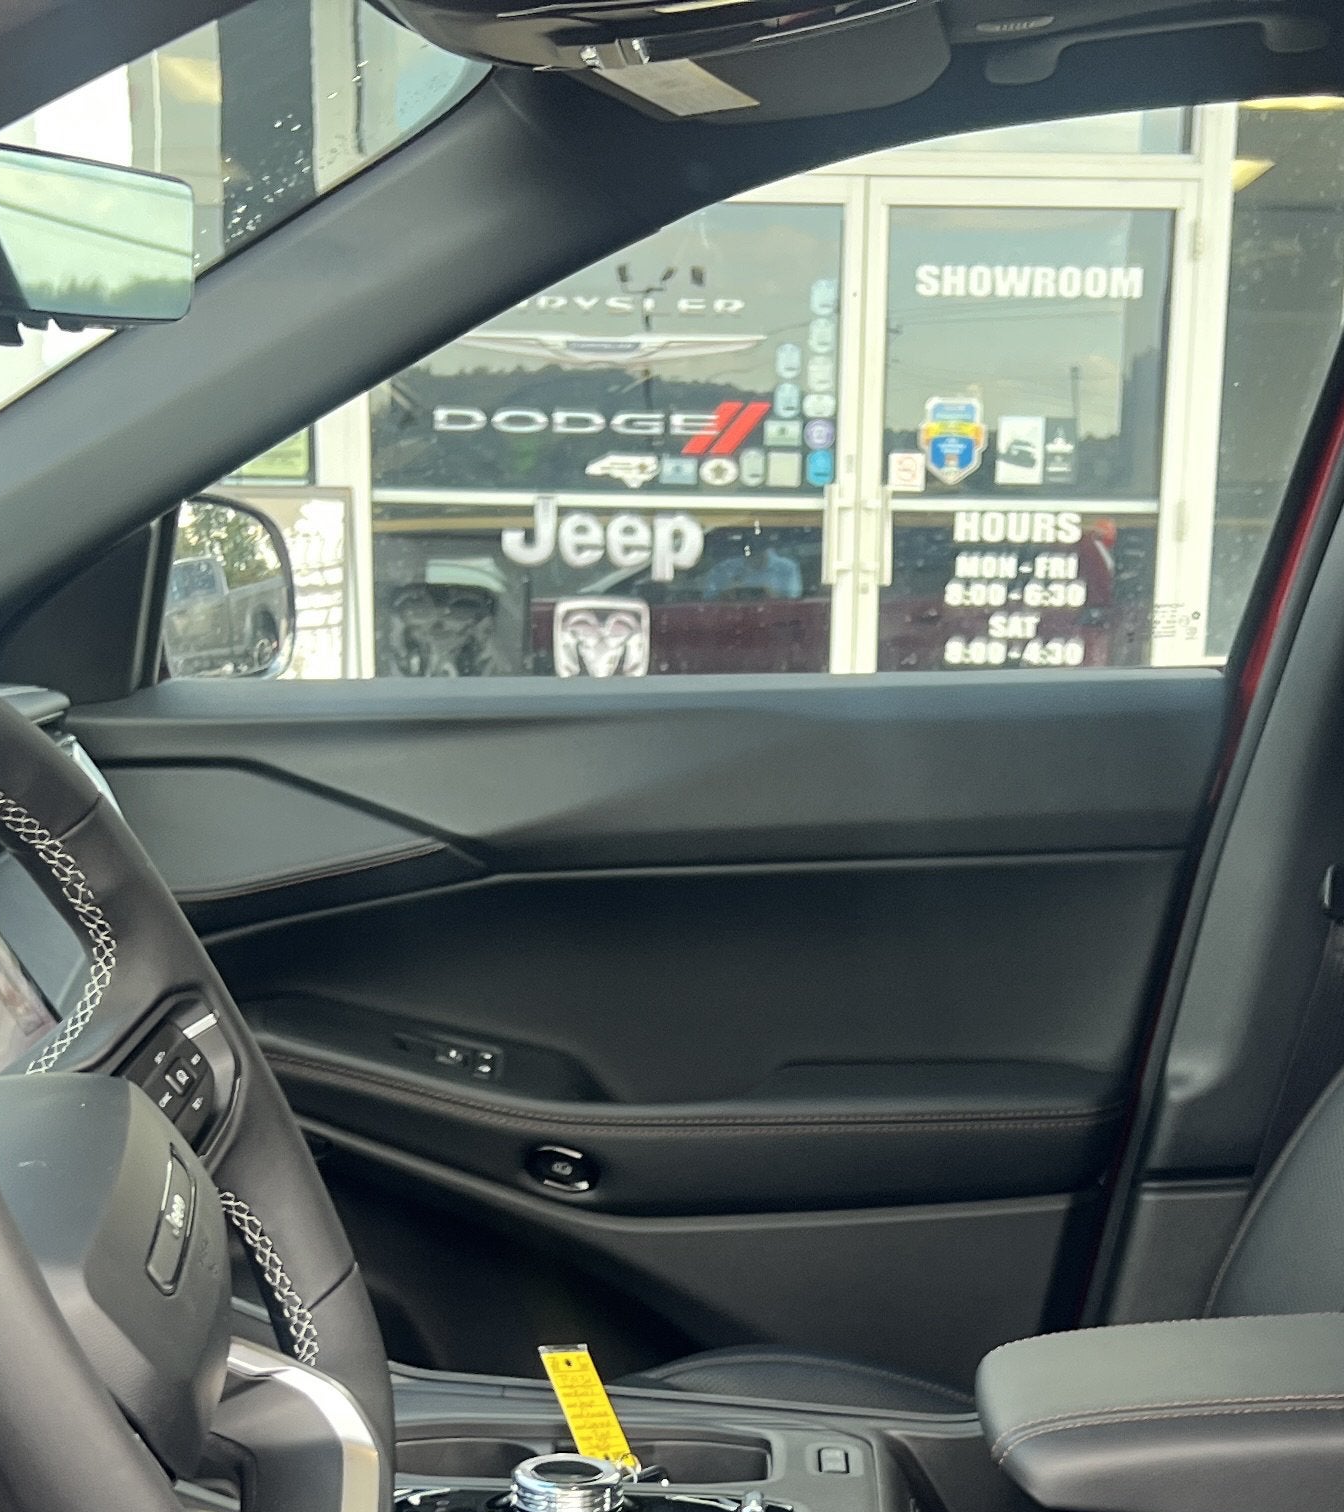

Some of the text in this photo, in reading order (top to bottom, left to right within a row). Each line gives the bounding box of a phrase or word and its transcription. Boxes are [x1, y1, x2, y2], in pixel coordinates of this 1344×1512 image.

[916, 264, 1143, 298] SHOWROOM
[433, 407, 720, 436] DODGE
[501, 496, 704, 582] Jeep
[953, 511, 1083, 544] HOURS
[988, 611, 1040, 639] SAT
